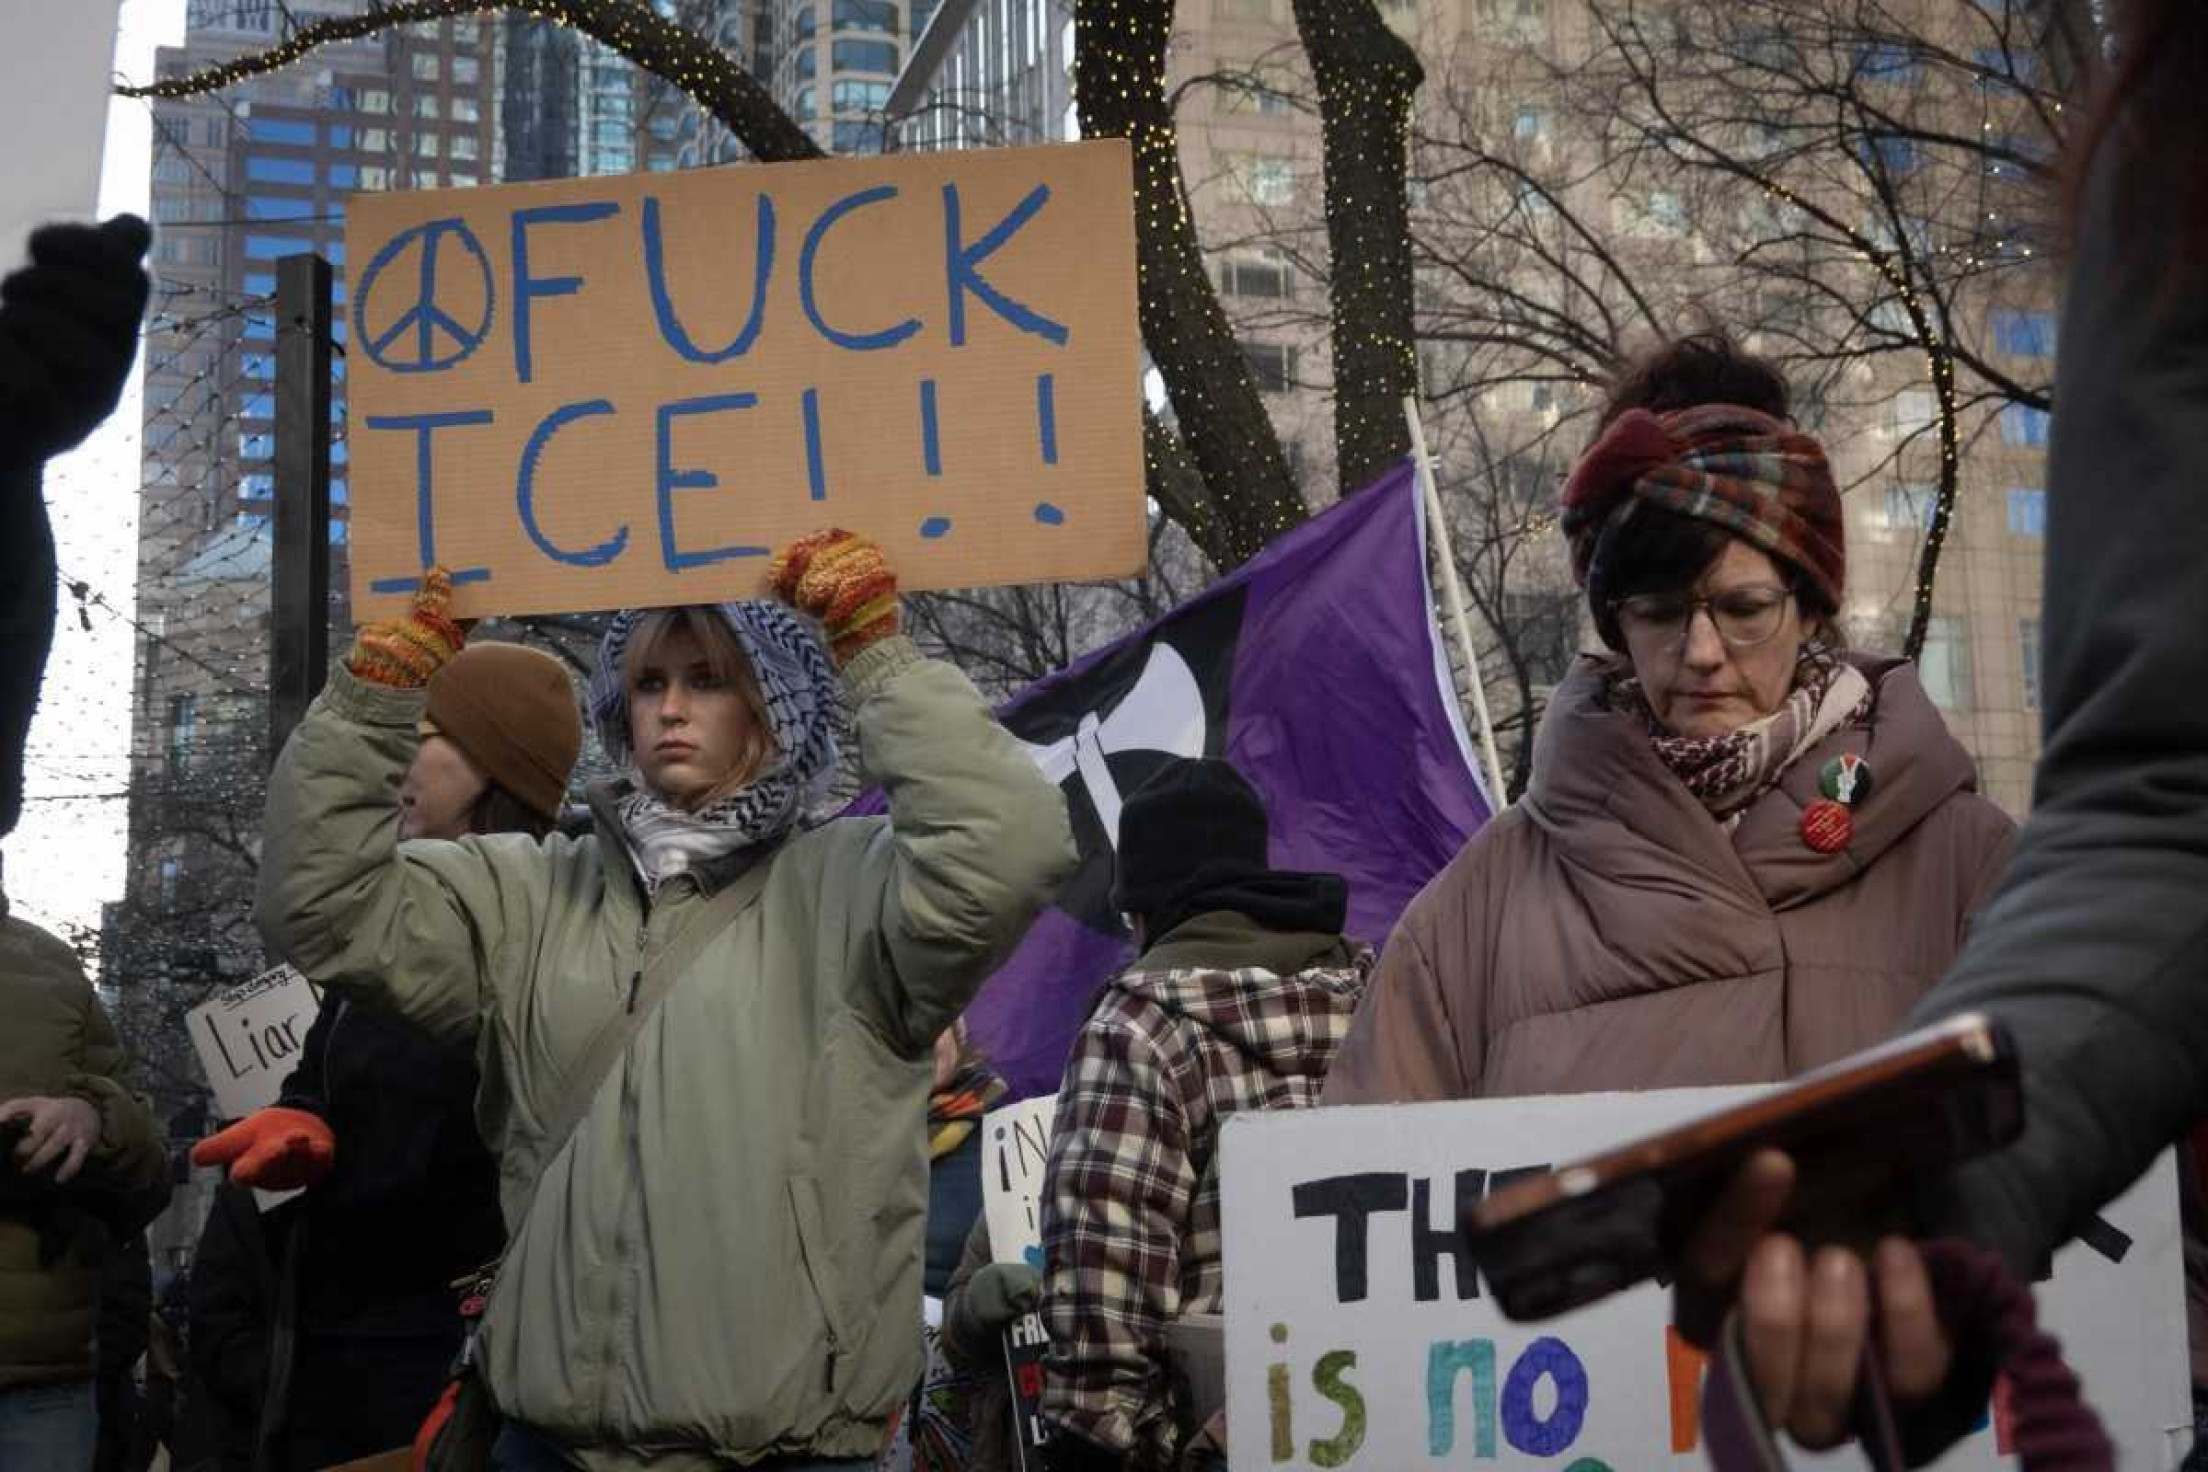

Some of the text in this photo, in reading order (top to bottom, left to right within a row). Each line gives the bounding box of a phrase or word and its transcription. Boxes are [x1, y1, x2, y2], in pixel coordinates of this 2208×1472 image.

[512, 183, 1070, 384] FUCK
[365, 373, 1065, 594] ICE!!!
[206, 1013, 300, 1079] Liar
[1292, 1163, 1552, 1303] TH
[1267, 1322, 1367, 1468] is
[1427, 1336, 1589, 1458] no
